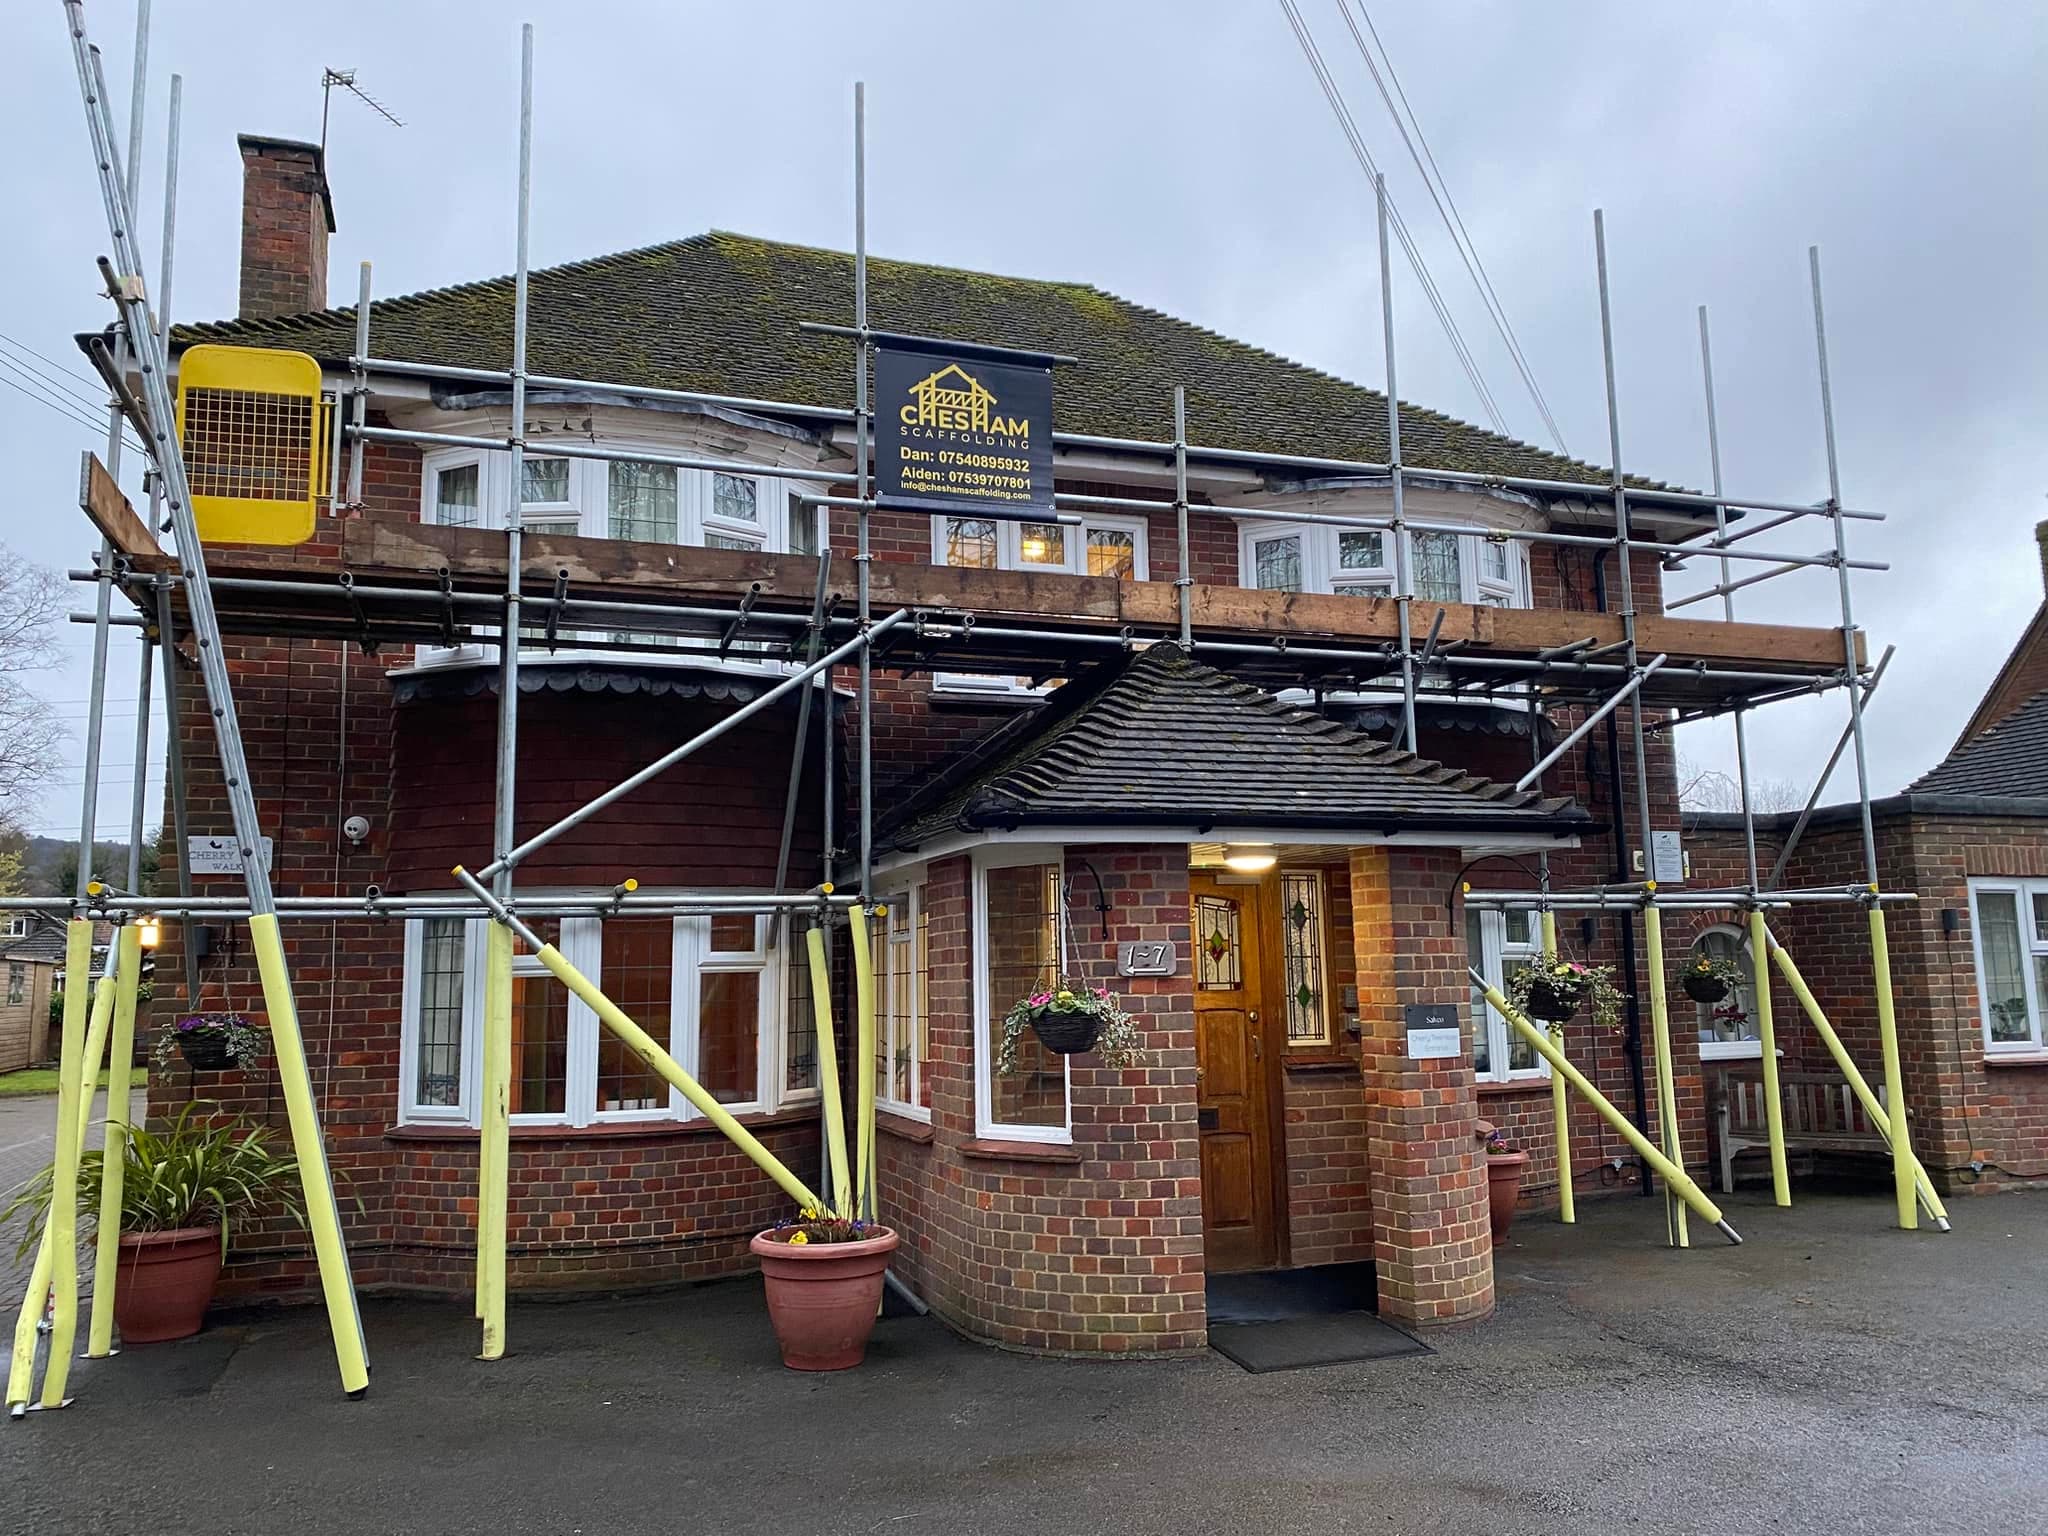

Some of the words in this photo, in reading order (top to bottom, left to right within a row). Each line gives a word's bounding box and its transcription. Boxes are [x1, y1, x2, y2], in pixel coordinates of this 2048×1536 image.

[900, 402, 1029, 438] CHESHAM
[900, 426, 1029, 449] SCAFFOLDING
[900, 446, 935, 462] Dan:
[939, 451, 1030, 472] 07540895932
[901, 466, 945, 481] Aiden:
[949, 471, 1031, 490] 07539707801
[189, 851, 235, 860] CHERRY
